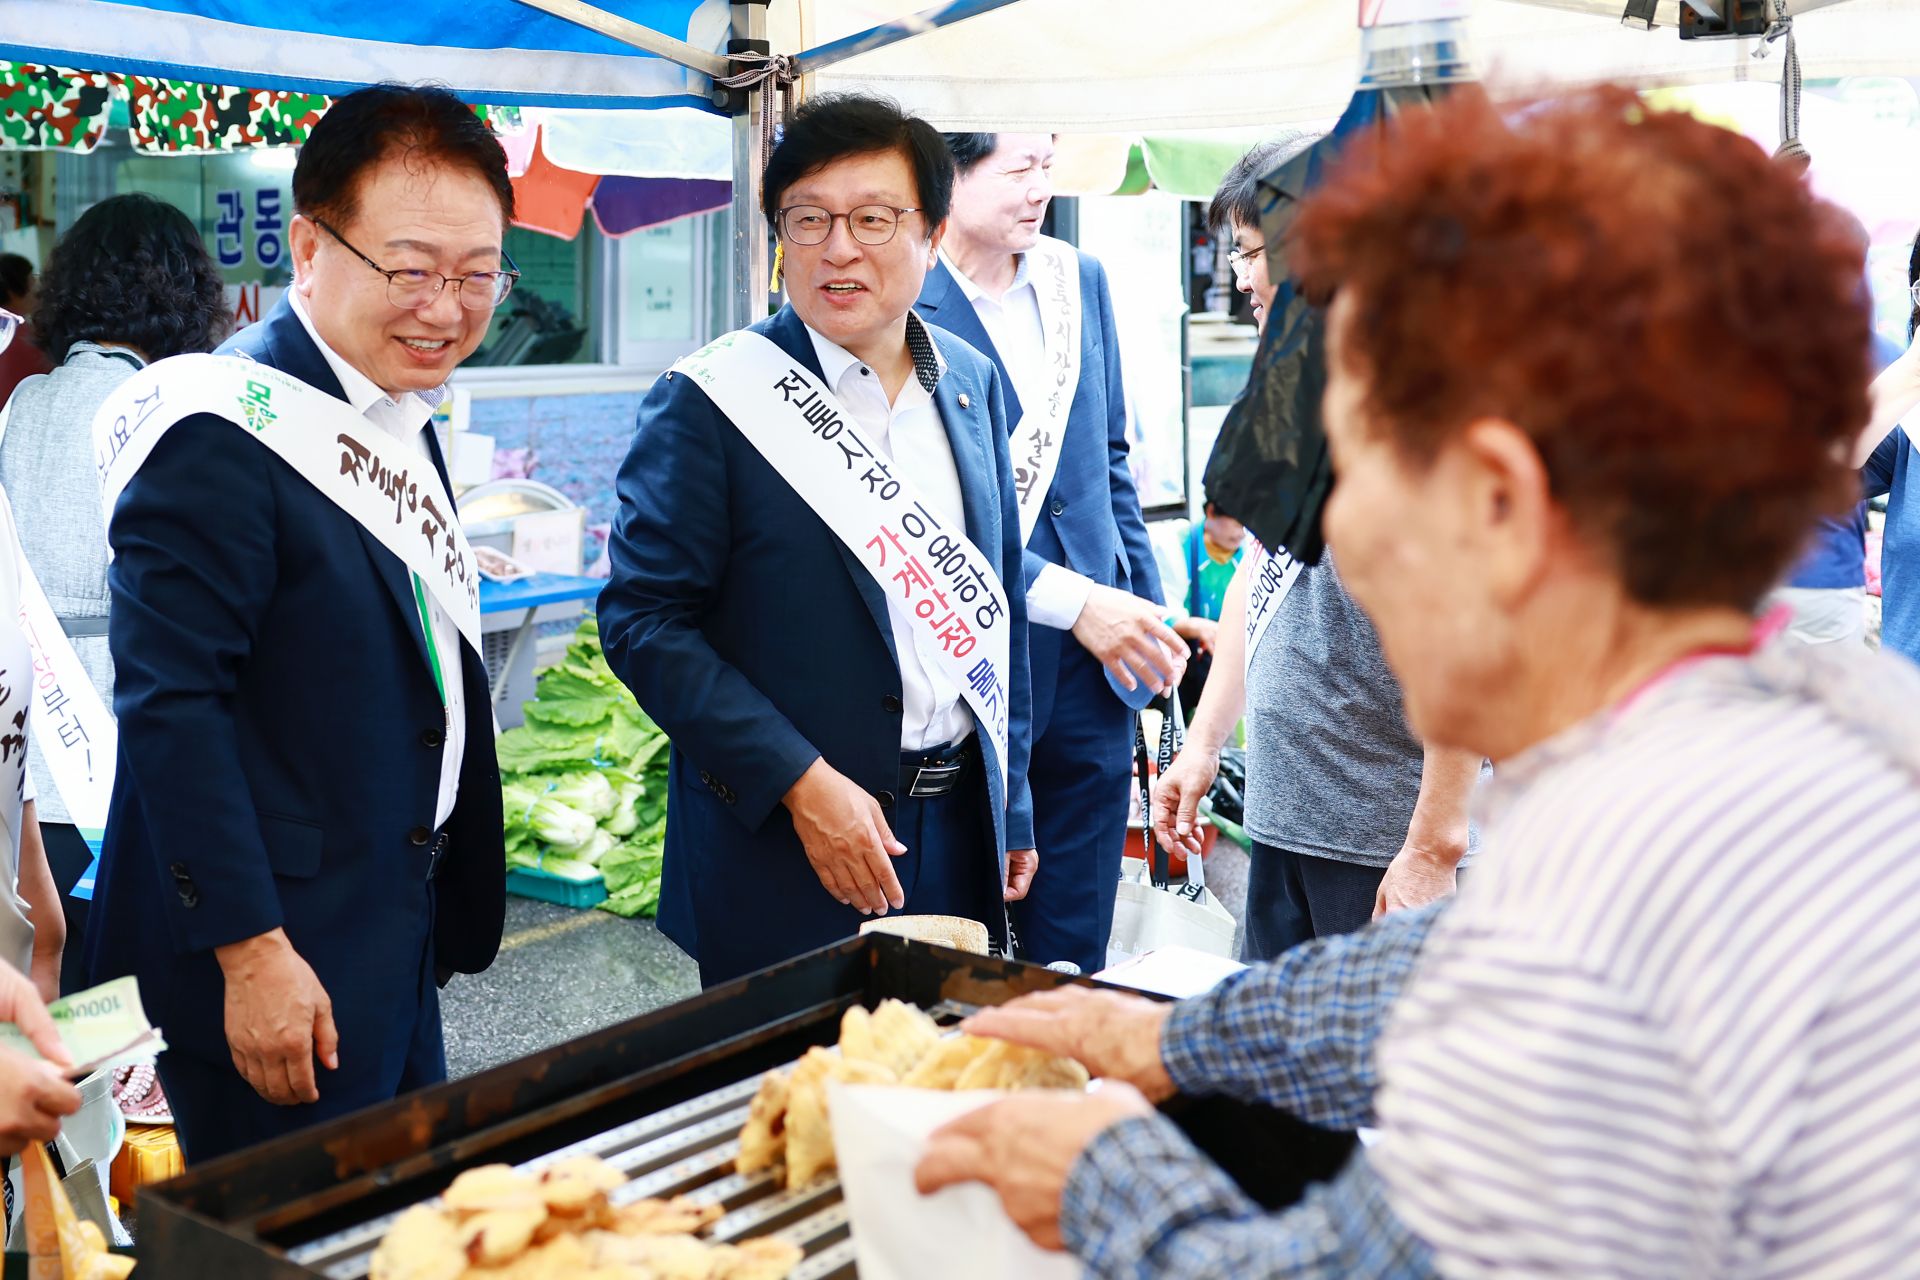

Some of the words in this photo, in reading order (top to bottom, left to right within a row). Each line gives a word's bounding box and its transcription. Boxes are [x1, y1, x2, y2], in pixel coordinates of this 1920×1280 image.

[773, 368, 901, 501] 전통시장
[901, 500, 1004, 630] 이용하여
[866, 524, 977, 658] 가계안정
